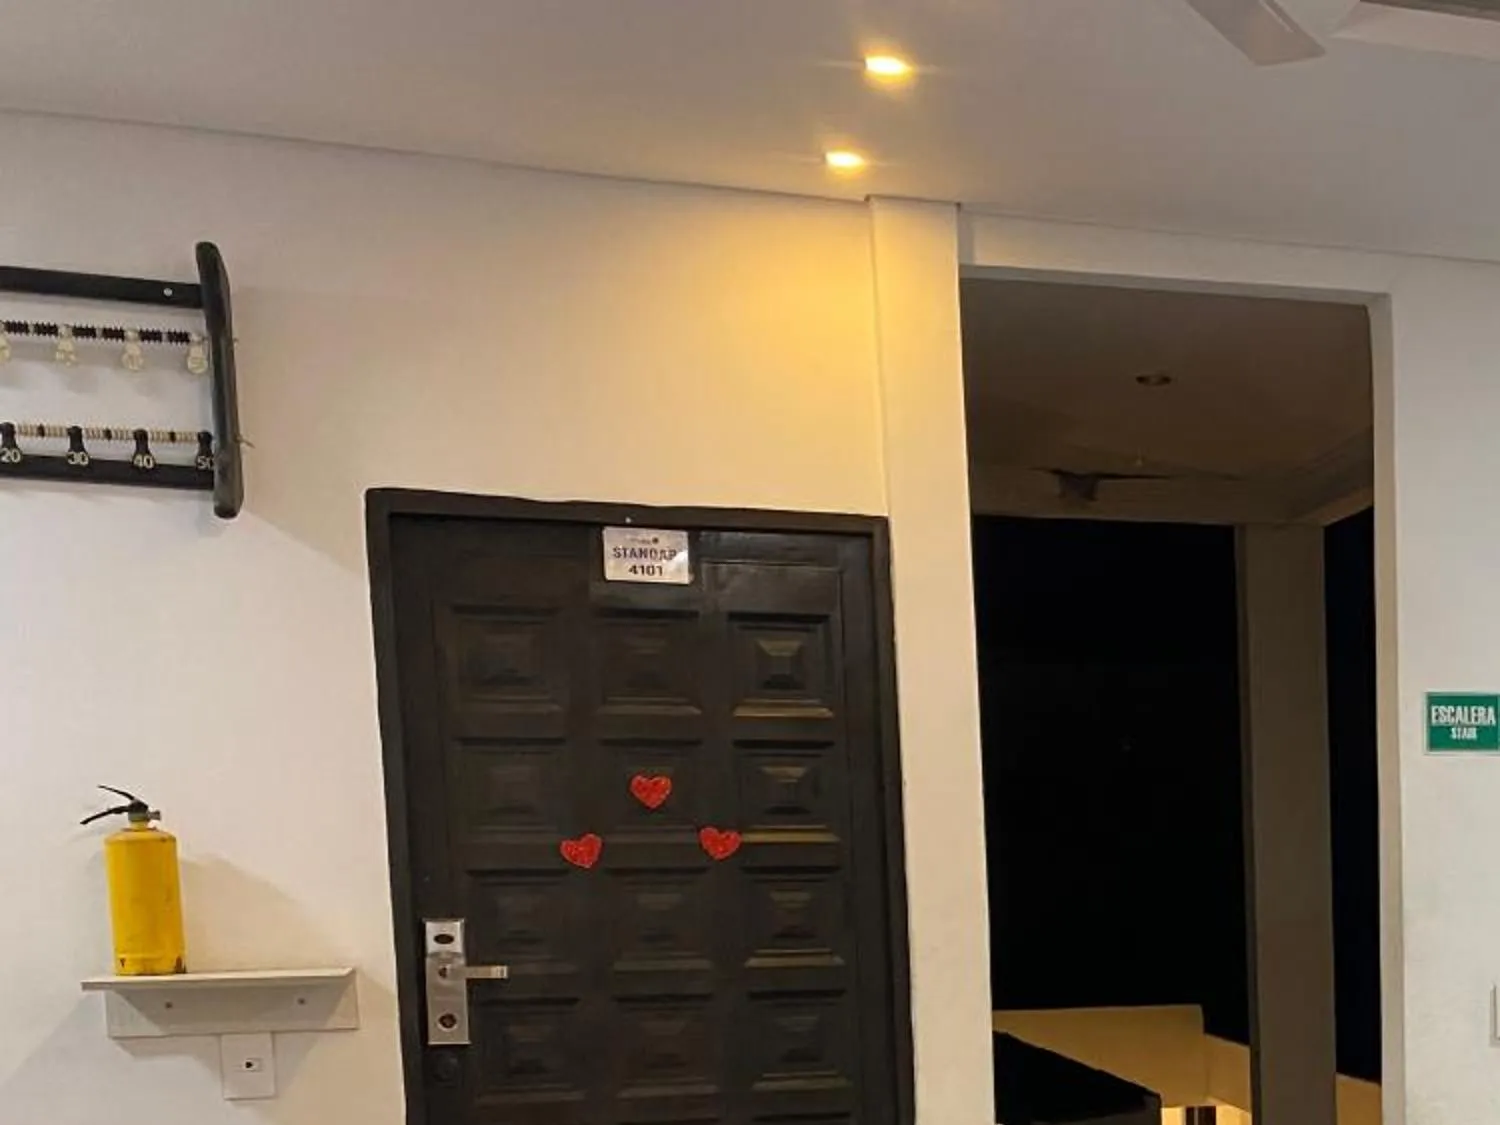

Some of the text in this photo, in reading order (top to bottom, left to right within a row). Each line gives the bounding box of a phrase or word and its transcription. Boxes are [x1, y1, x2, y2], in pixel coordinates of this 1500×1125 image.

[67, 451, 89, 466] 30
[133, 454, 154, 470] 40
[628, 565, 663, 576] 4101
[1431, 705, 1497, 726] ESCALERA
